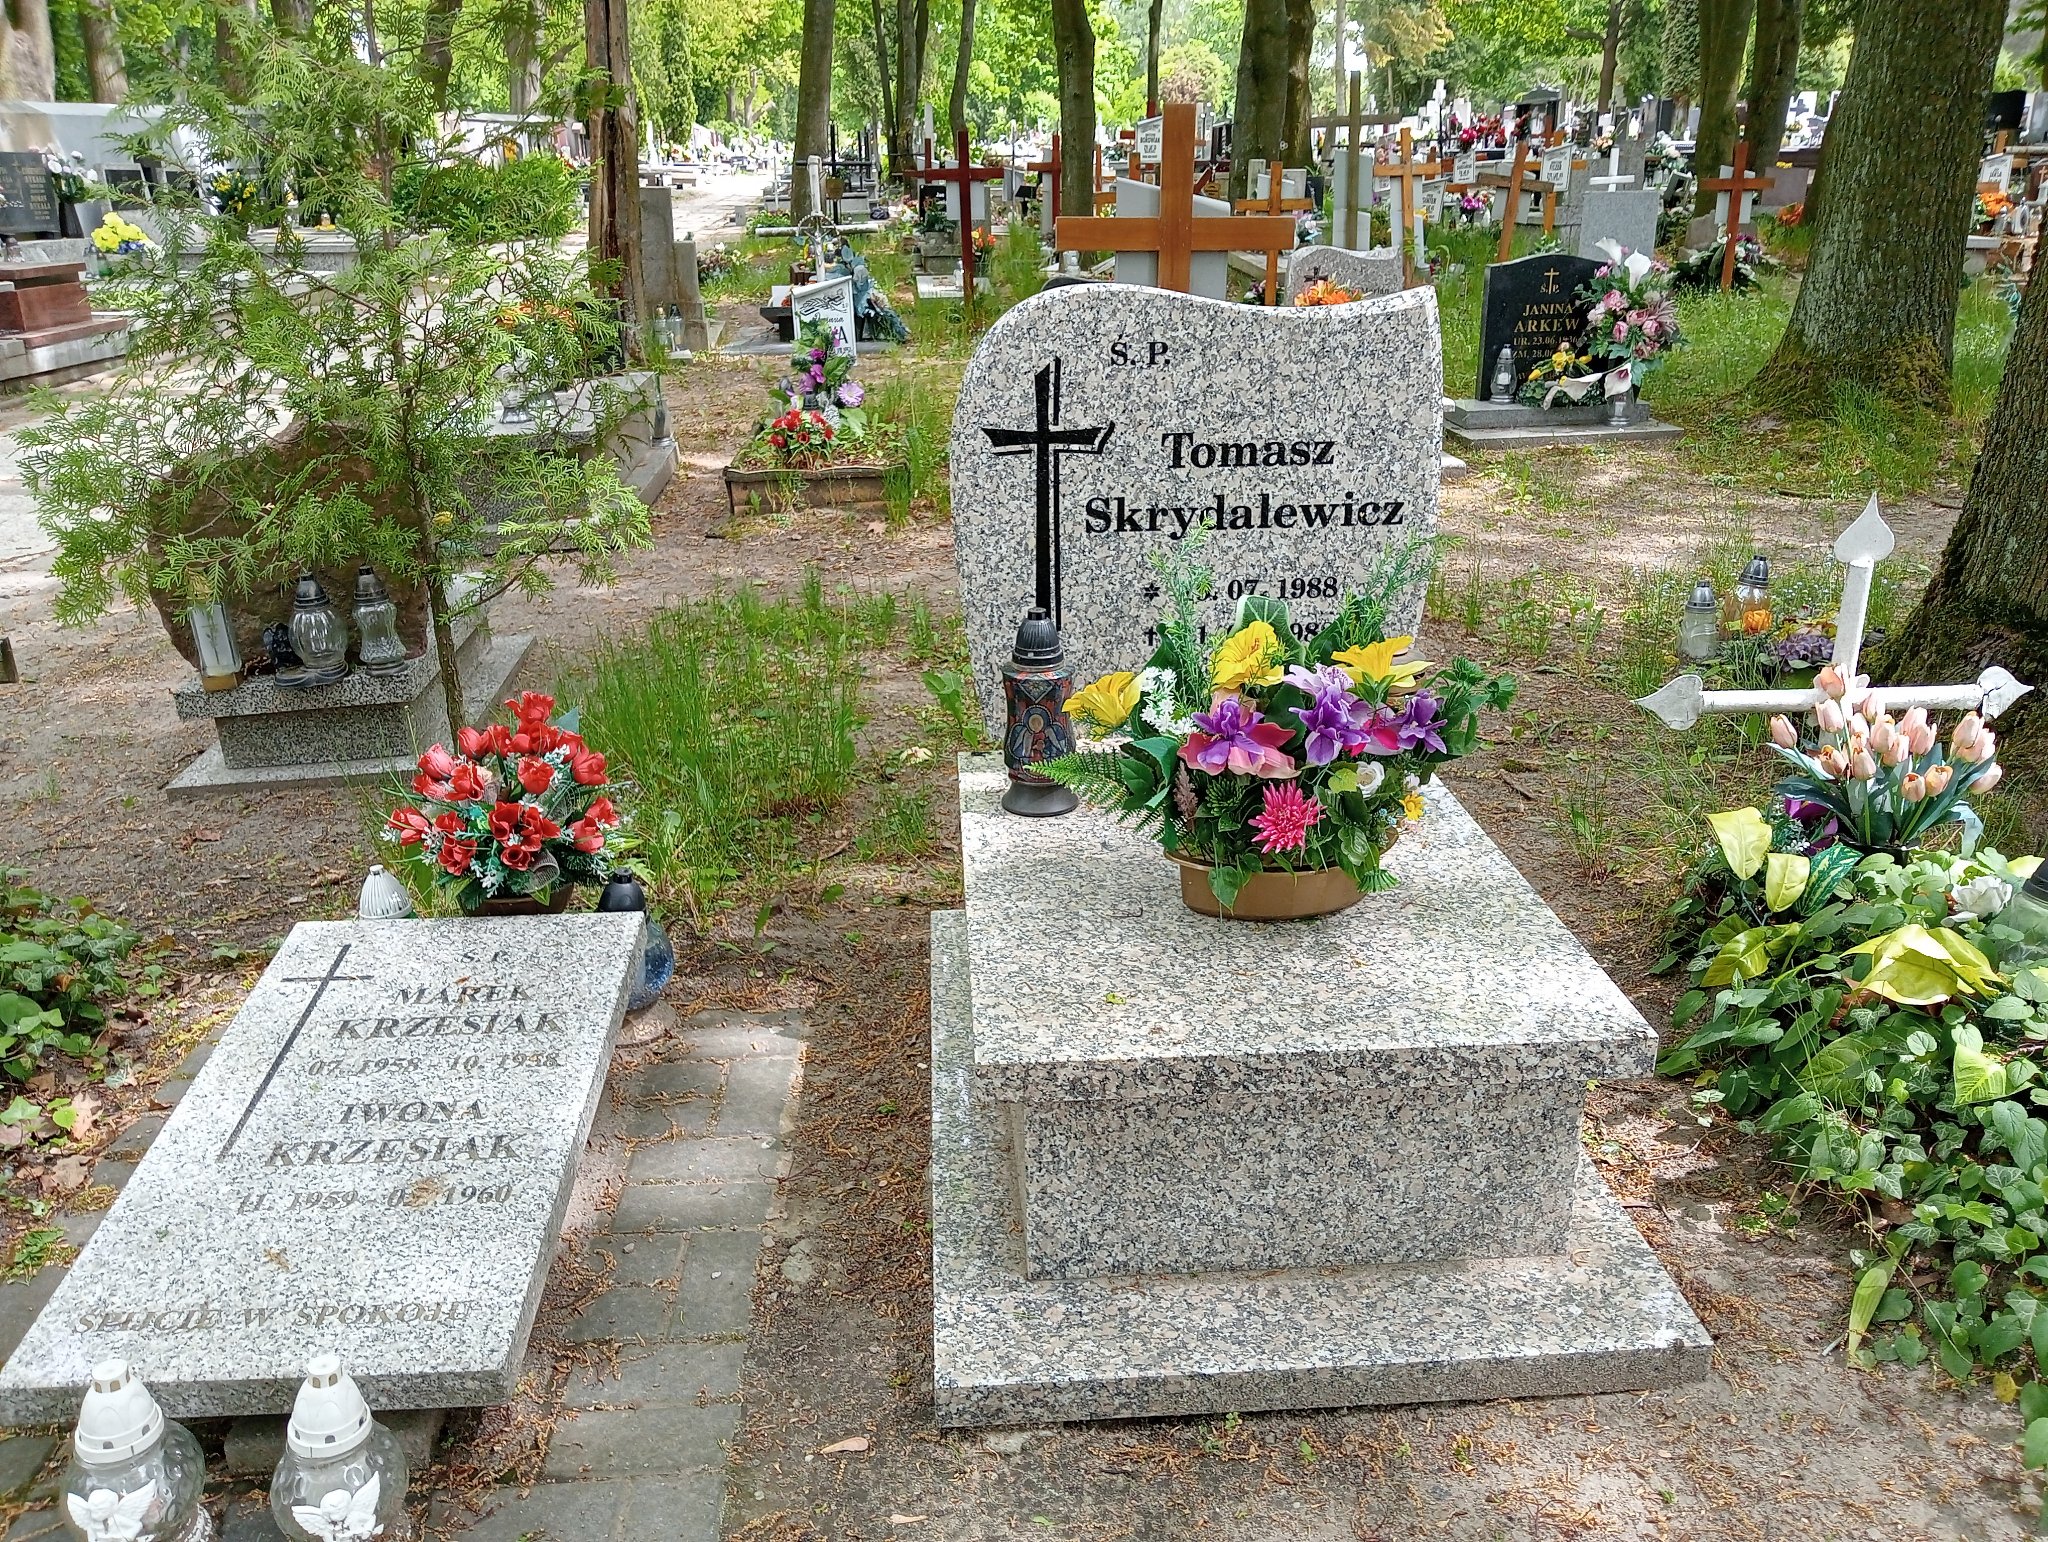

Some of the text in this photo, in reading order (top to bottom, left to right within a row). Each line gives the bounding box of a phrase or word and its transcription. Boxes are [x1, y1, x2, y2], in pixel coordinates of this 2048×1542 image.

[1523, 303, 1573, 317] JANINA
[1110, 333, 1171, 367] Ś. P.
[1161, 432, 1335, 470] Tomasz
[1085, 491, 1405, 540] Skrydalewicz
[1277, 576, 1339, 601] 1988
[393, 983, 535, 1006] MAREK
[333, 1012, 567, 1041] KRZESIAK
[337, 1100, 485, 1125] IWONA
[264, 1132, 528, 1168] KRZESIAK
[441, 1183, 514, 1207] 1960
[243, 1307, 278, 1328] W
